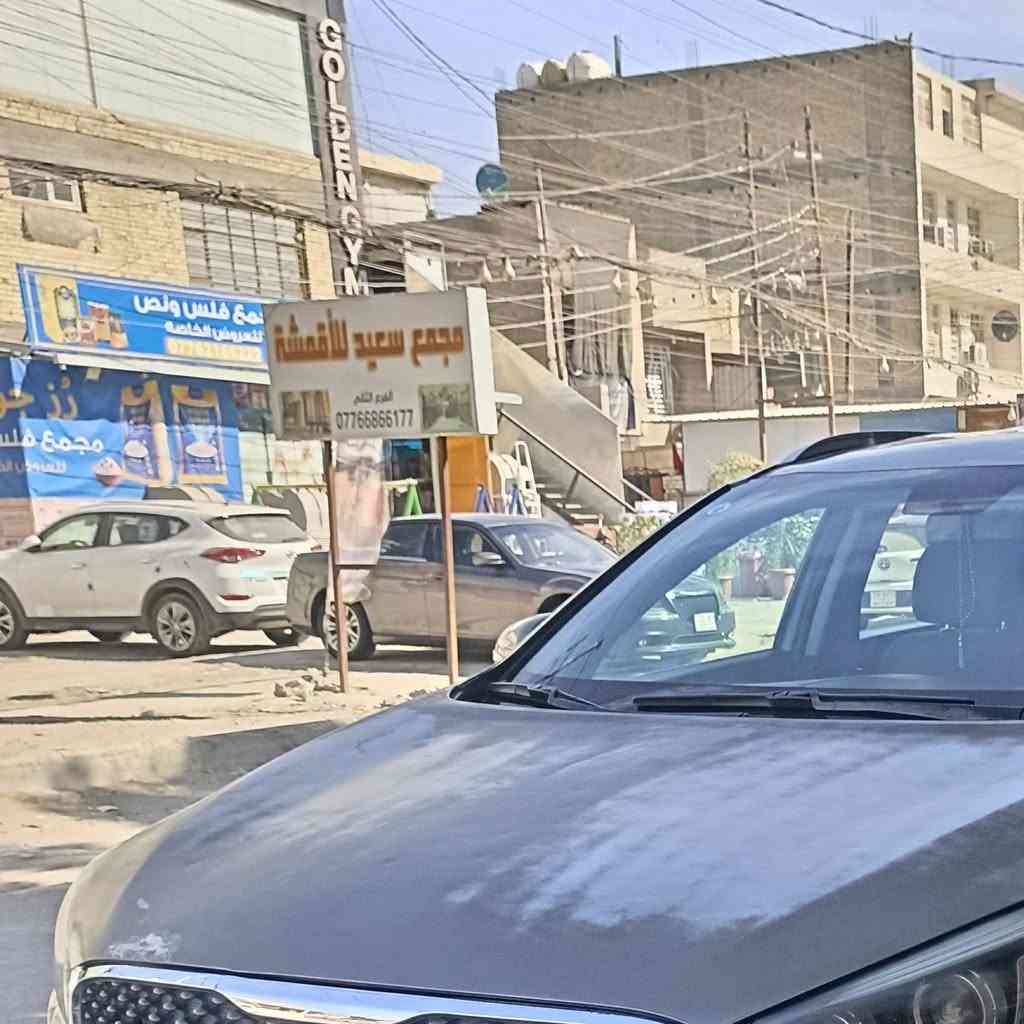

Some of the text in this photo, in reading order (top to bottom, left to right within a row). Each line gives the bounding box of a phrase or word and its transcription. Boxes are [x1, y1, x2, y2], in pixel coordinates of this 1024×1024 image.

[318, 18, 369, 296] GOLDEN GYM
[182, 302, 231, 320] فلس
[353, 328, 405, 371] سعيد
[411, 325, 464, 367] مجمع
[41, 430, 104, 455] مجمع
